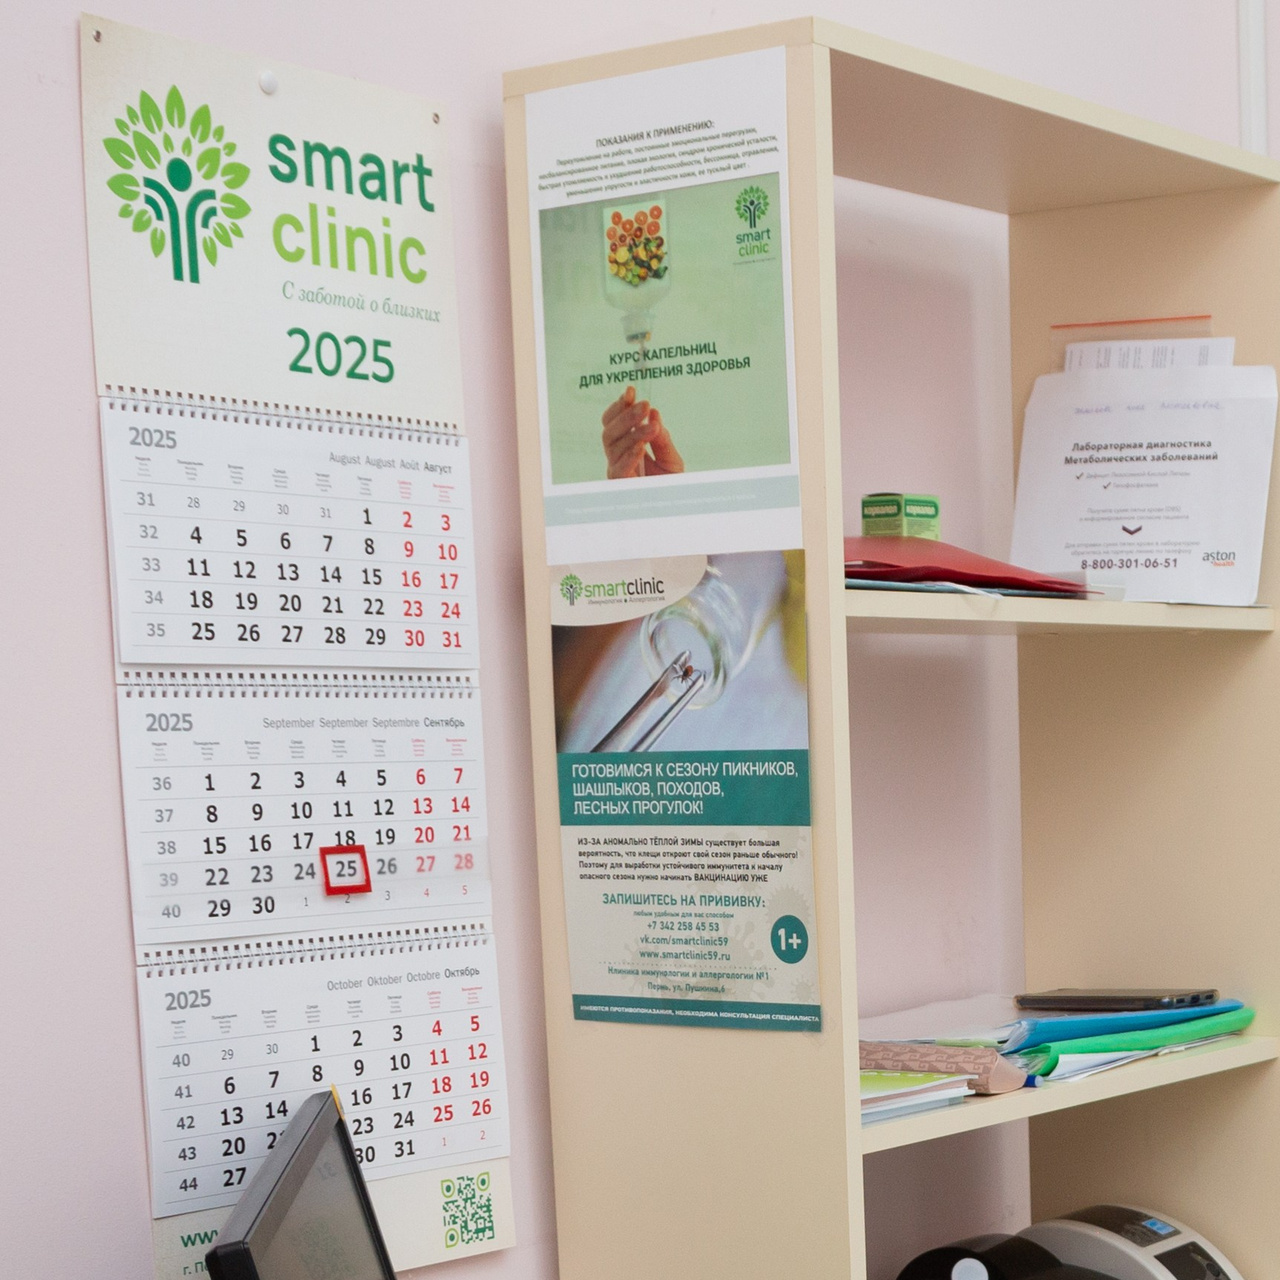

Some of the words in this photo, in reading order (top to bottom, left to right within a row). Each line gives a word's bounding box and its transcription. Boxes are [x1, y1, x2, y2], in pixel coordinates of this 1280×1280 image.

[596, 131, 644, 148] ПОКАЗАНИЯ
[646, 130, 652, 139] К
[653, 120, 715, 138] ПРИМЕНЕНИЮ:
[268, 133, 435, 213] smart
[273, 203, 427, 283] clinic
[736, 228, 771, 244] smart
[738, 242, 768, 256] clinic
[299, 287, 364, 310] заботой
[383, 300, 441, 323] близких
[287, 328, 394, 383] 2025
[609, 352, 640, 365] КУРС
[642, 342, 717, 361] КАПЕЛЬНИЦ
[579, 375, 603, 389] ДЛЯ
[606, 365, 683, 383] УКРЕПЛЕНИЯ
[686, 357, 751, 375] ЗДОРОВЬЯ
[129, 427, 177, 449] 2025
[1072, 443, 1143, 452] Лабораторная
[1146, 440, 1212, 450] диагностика
[329, 452, 360, 466] August
[365, 456, 395, 469] August
[423, 463, 452, 474] Август
[1065, 456, 1147, 464] Метаболических
[1150, 452, 1218, 462] заболеваний
[1081, 558, 1177, 570] 8-800-301-06-51
[1202, 551, 1236, 562] aston
[585, 577, 664, 597] smartclinic
[147, 623, 165, 637] 35
[192, 622, 215, 640] 25
[238, 624, 260, 642] 26
[282, 625, 303, 642] 27
[325, 627, 345, 644] 28
[366, 628, 385, 645] 29
[405, 630, 424, 646] 30
[443, 631, 461, 648] 31
[146, 713, 193, 732] 2025
[263, 717, 314, 729] September
[319, 717, 368, 729] September
[372, 717, 419, 728] Septembre
[423, 717, 464, 728] Сентябрь
[572, 763, 652, 777] ГОТОВИМСЯ
[656, 764, 663, 776] К
[666, 763, 718, 777] СЕЗОНУ
[723, 761, 798, 778] ПИКНИКОВ,
[153, 777, 171, 791] 36
[205, 774, 215, 791] 1
[251, 772, 261, 789] 2
[295, 771, 304, 788] 3
[336, 771, 346, 787] 4
[377, 770, 386, 786] 5
[416, 769, 425, 785] 6
[454, 768, 463, 783] 7
[573, 782, 653, 797] ШАШЛЫКОВ,
[657, 781, 724, 797] ПОХОДОВ,
[574, 801, 630, 815] ЛЕСНЫХ
[633, 801, 703, 814] ПРОГУЛОК!
[650, 836, 678, 846] ТЁПЛОЙ
[681, 838, 703, 846] ЗИМЫ
[705, 840, 746, 848] существует
[762, 851, 798, 859] обычного!
[160, 873, 178, 887] 39
[205, 868, 229, 886] 22
[251, 865, 273, 883] 23
[294, 863, 316, 880] 24
[336, 860, 357, 877] 25
[377, 858, 397, 875] 26
[416, 856, 435, 872] 27
[455, 853, 474, 870] 28
[579, 861, 607, 869] Поэтому
[625, 861, 660, 869] выработки
[663, 862, 705, 871] устойчивого
[694, 873, 749, 882] ВАКЦИНАЦИЮ
[751, 874, 768, 882] УЖЕ
[603, 893, 677, 905] ЗАПИШИТЕСЬ
[681, 895, 696, 906] НА
[700, 895, 765, 907] ПРИВИВКУ:
[647, 921, 657, 930] +7
[660, 922, 674, 930] 342
[677, 922, 692, 931] 258
[696, 922, 706, 931] 45
[709, 922, 719, 931] 53
[640, 935, 728, 946] vk.com/smartclinic59
[778, 928, 801, 950] 1+
[639, 950, 730, 961] www.smartclinic59.ru
[327, 979, 363, 992] October
[367, 975, 402, 987] Oktober
[406, 970, 440, 982] Octobre
[444, 967, 480, 979] Октябрь
[608, 967, 639, 975] Клиника
[165, 989, 211, 1011] 2025
[175, 1085, 192, 1098] 41
[225, 1077, 235, 1094] 6
[269, 1071, 279, 1088] 7
[313, 1065, 323, 1082] 8
[354, 1059, 364, 1076] 9
[390, 1053, 410, 1071] 10
[430, 1048, 449, 1065] 11
[468, 1043, 487, 1060] 12
